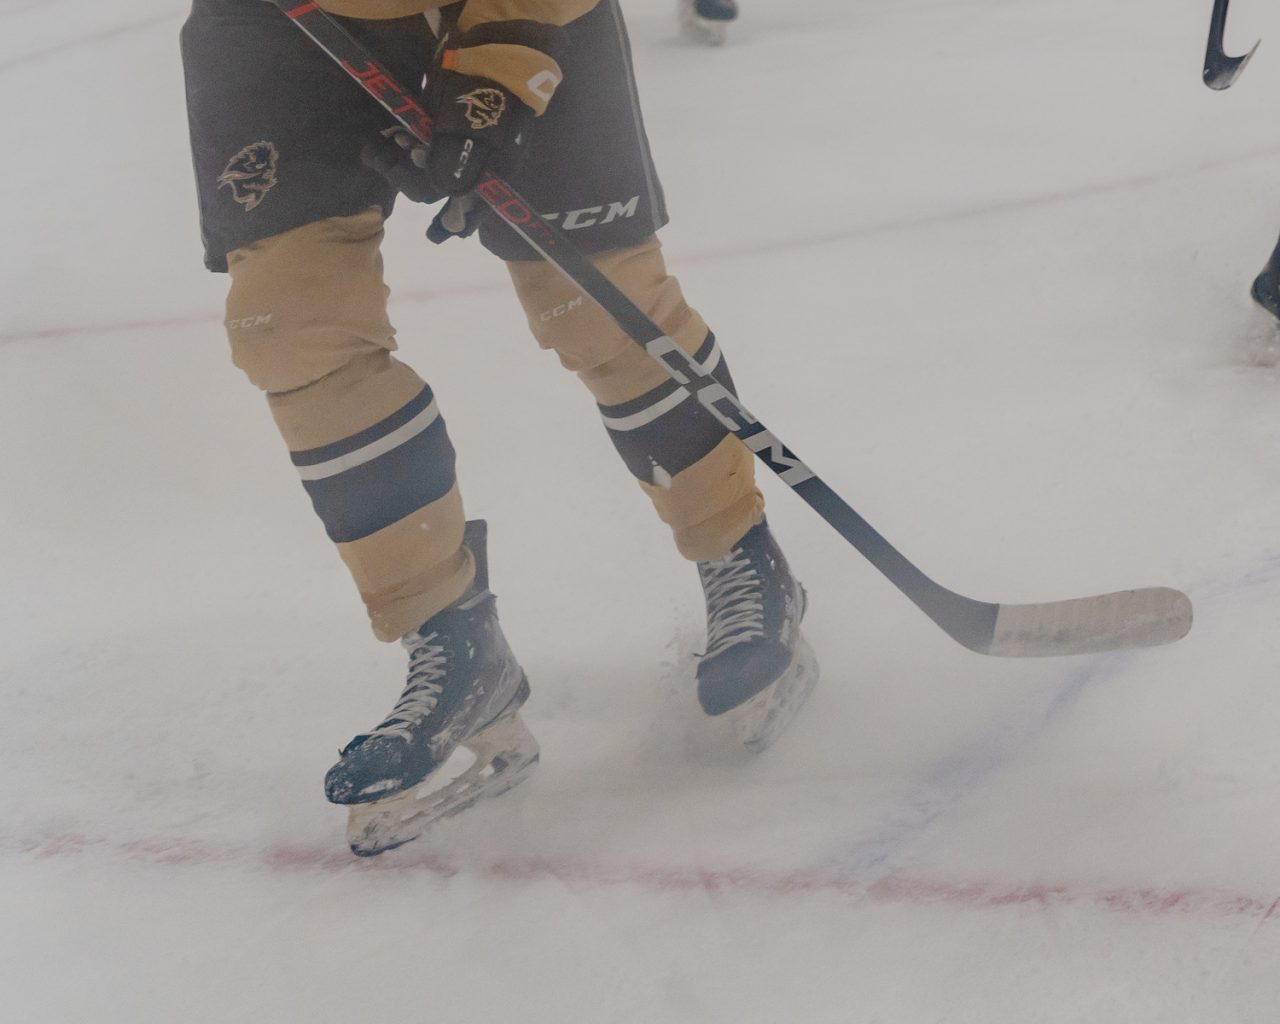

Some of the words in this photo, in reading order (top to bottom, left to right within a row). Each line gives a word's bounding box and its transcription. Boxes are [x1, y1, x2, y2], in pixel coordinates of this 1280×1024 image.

[340, 59, 532, 225] JETSED
[454, 138, 475, 179] CCM
[646, 335, 817, 488] CCM
